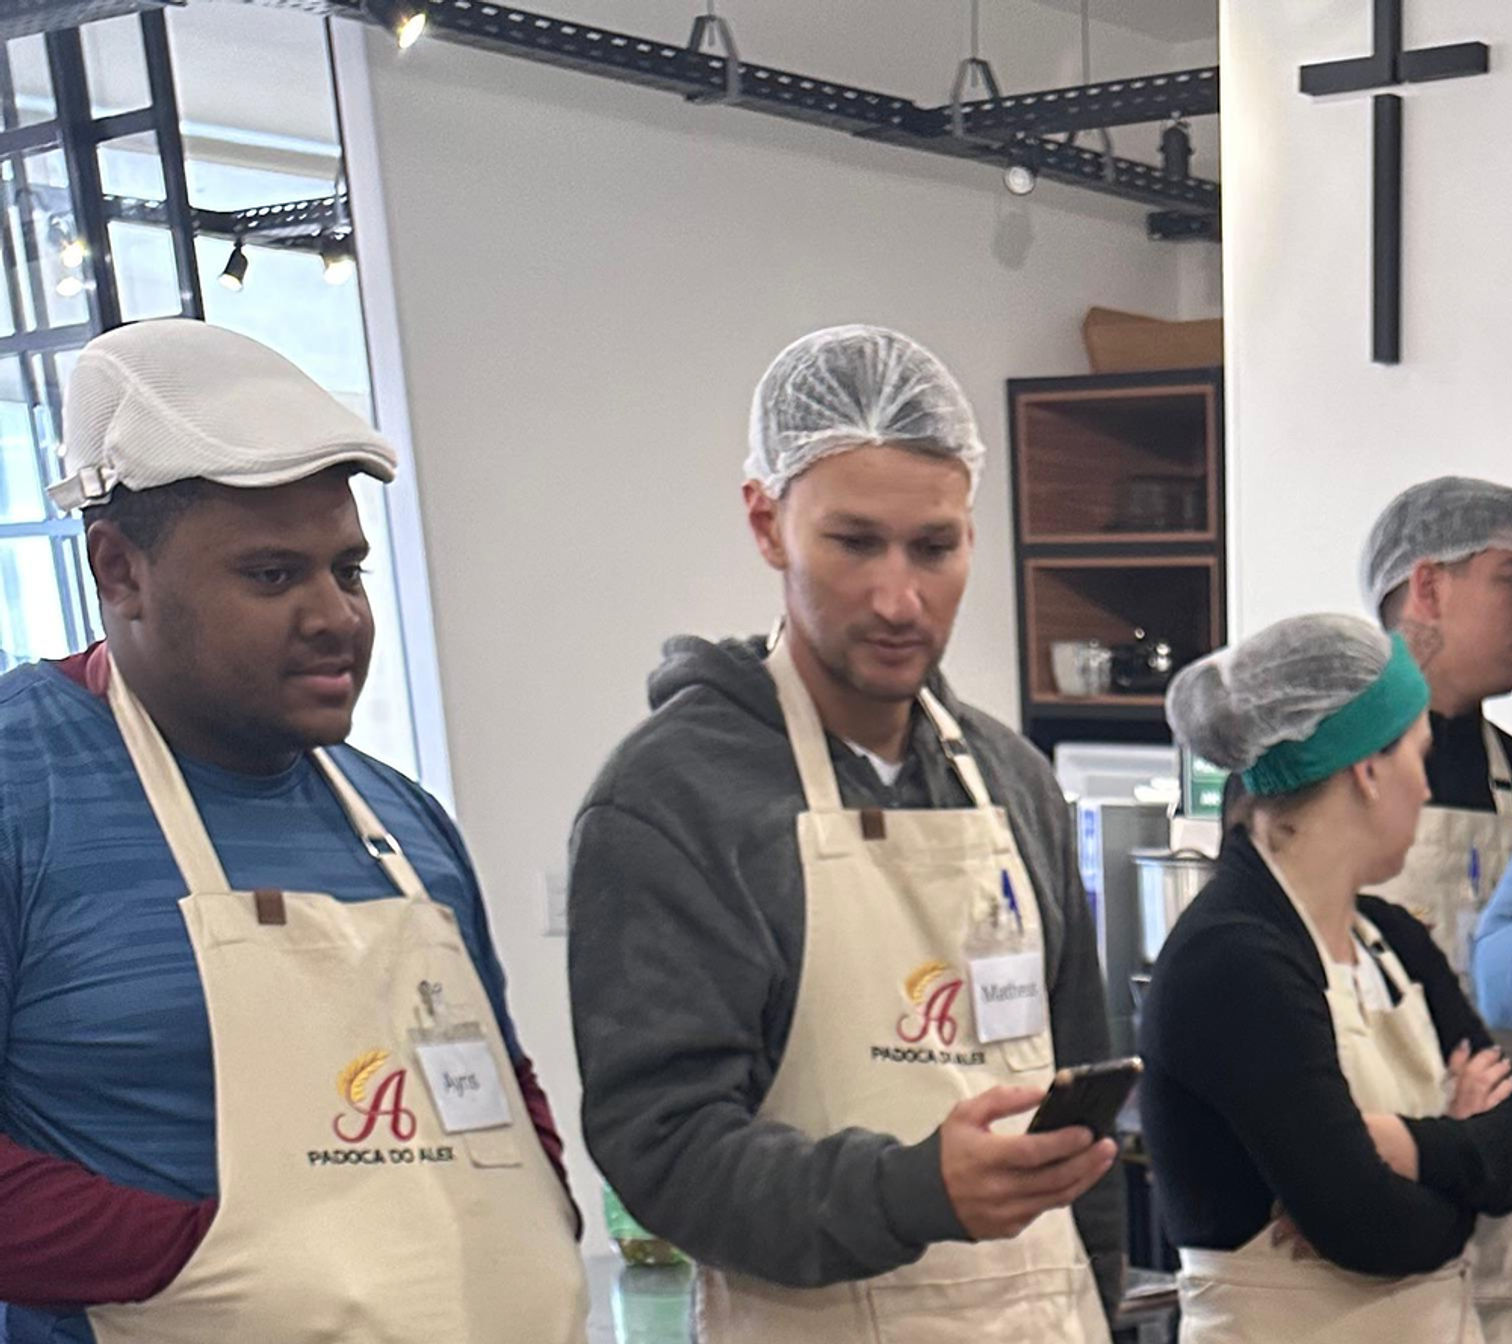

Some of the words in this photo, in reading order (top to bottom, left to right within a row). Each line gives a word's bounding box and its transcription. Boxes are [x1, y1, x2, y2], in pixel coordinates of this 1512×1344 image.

[896, 979, 964, 1047] A
[870, 1046, 937, 1064] PADOCA
[332, 1068, 418, 1144] A
[306, 1150, 387, 1166] PADOCA
[389, 1148, 415, 1164] DO
[419, 1147, 455, 1162] ALEX
